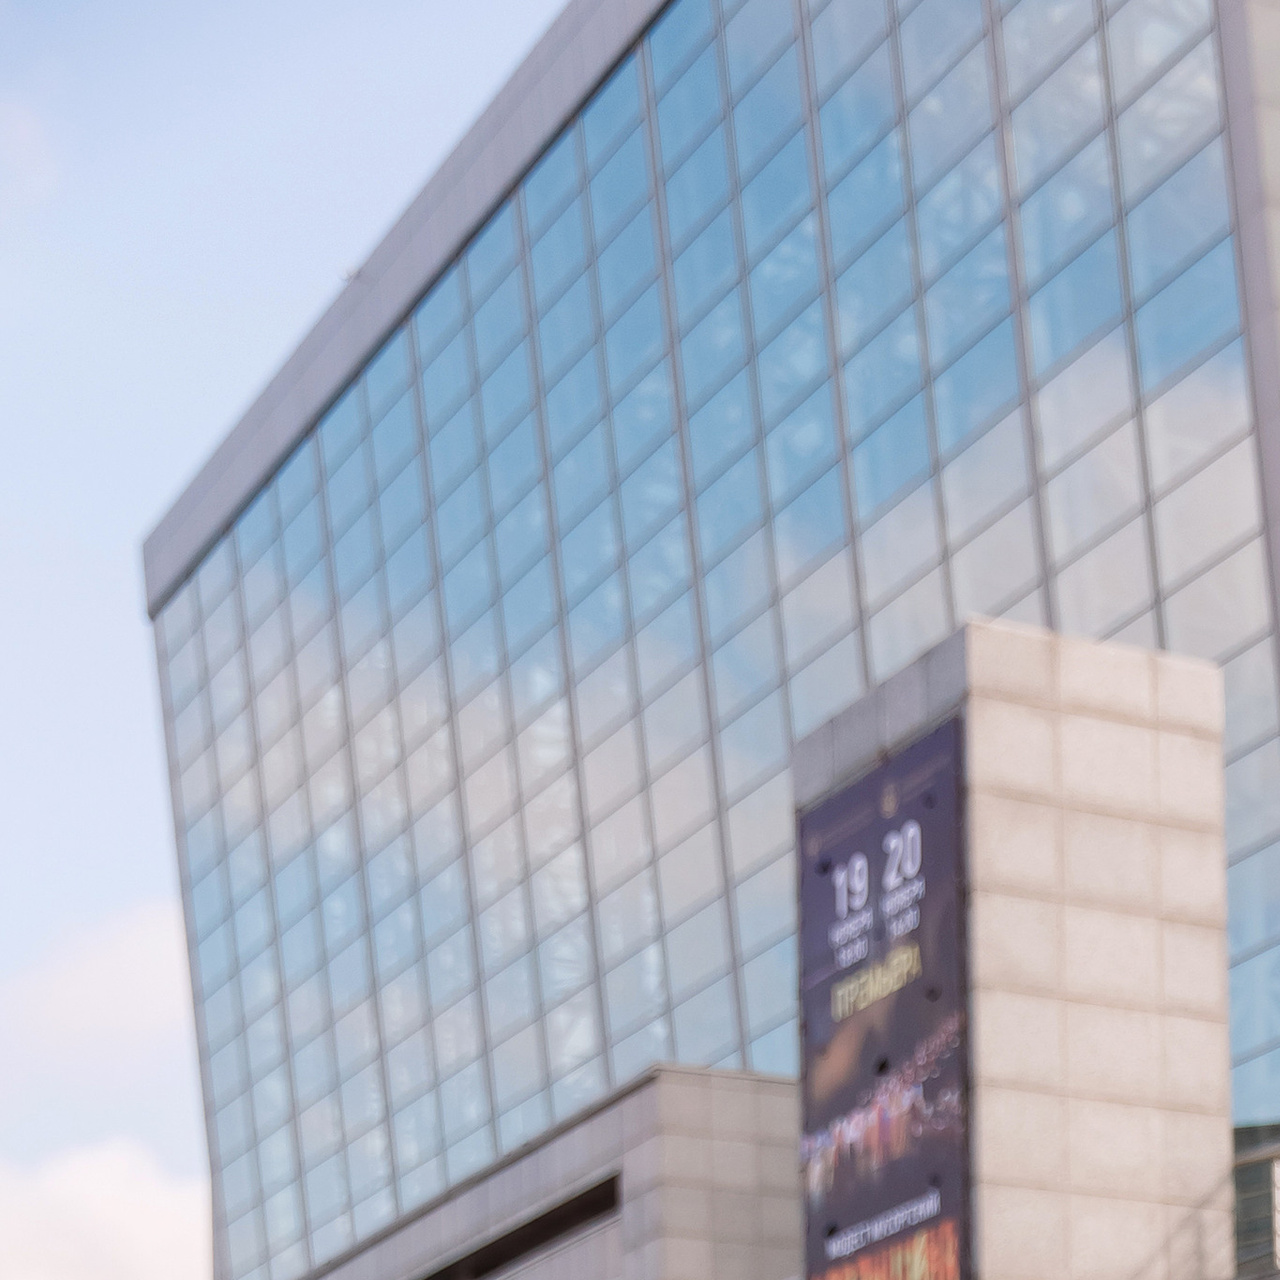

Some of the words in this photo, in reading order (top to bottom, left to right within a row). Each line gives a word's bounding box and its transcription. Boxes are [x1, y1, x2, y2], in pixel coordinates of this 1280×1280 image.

[831, 852, 869, 920] 19
[882, 819, 922, 891] 20
[831, 942, 922, 1023] ПРЕМЬЕРА
[826, 1224, 872, 1260] МОДЕСТ
